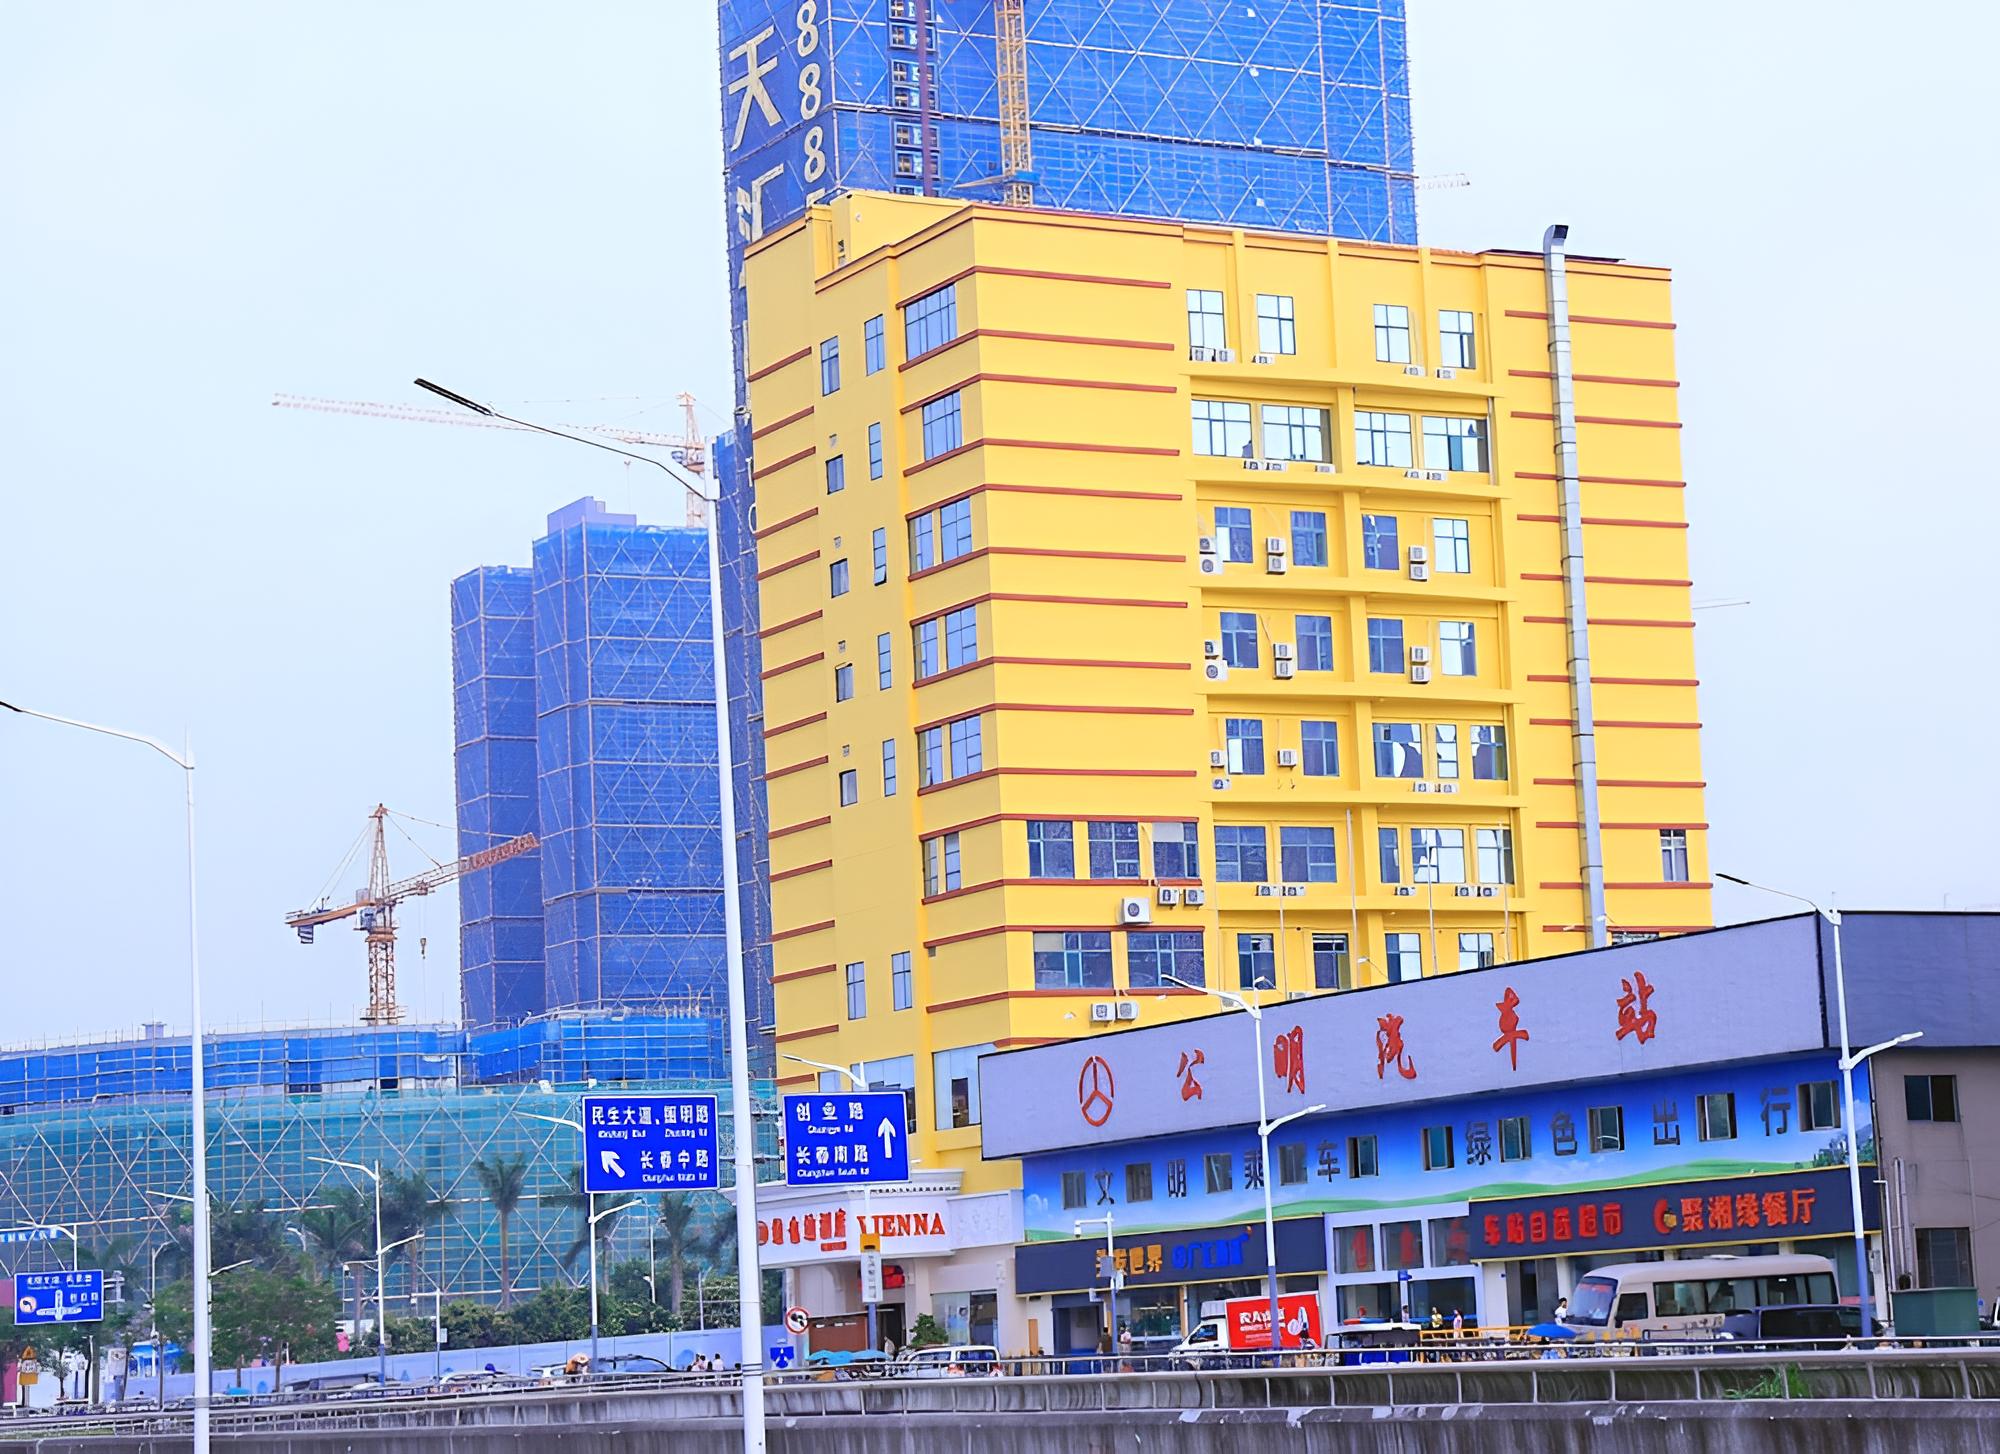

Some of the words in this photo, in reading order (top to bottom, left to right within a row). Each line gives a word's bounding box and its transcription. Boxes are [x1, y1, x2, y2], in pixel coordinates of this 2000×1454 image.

[796, 0, 826, 206] 888
[1177, 971, 1657, 1102] 公明汽车站
[1465, 1087, 1791, 1166] 绿色出行
[856, 1213, 945, 1237] VIENNA
[1680, 1188, 1816, 1232] 聚湘缘餐厅
